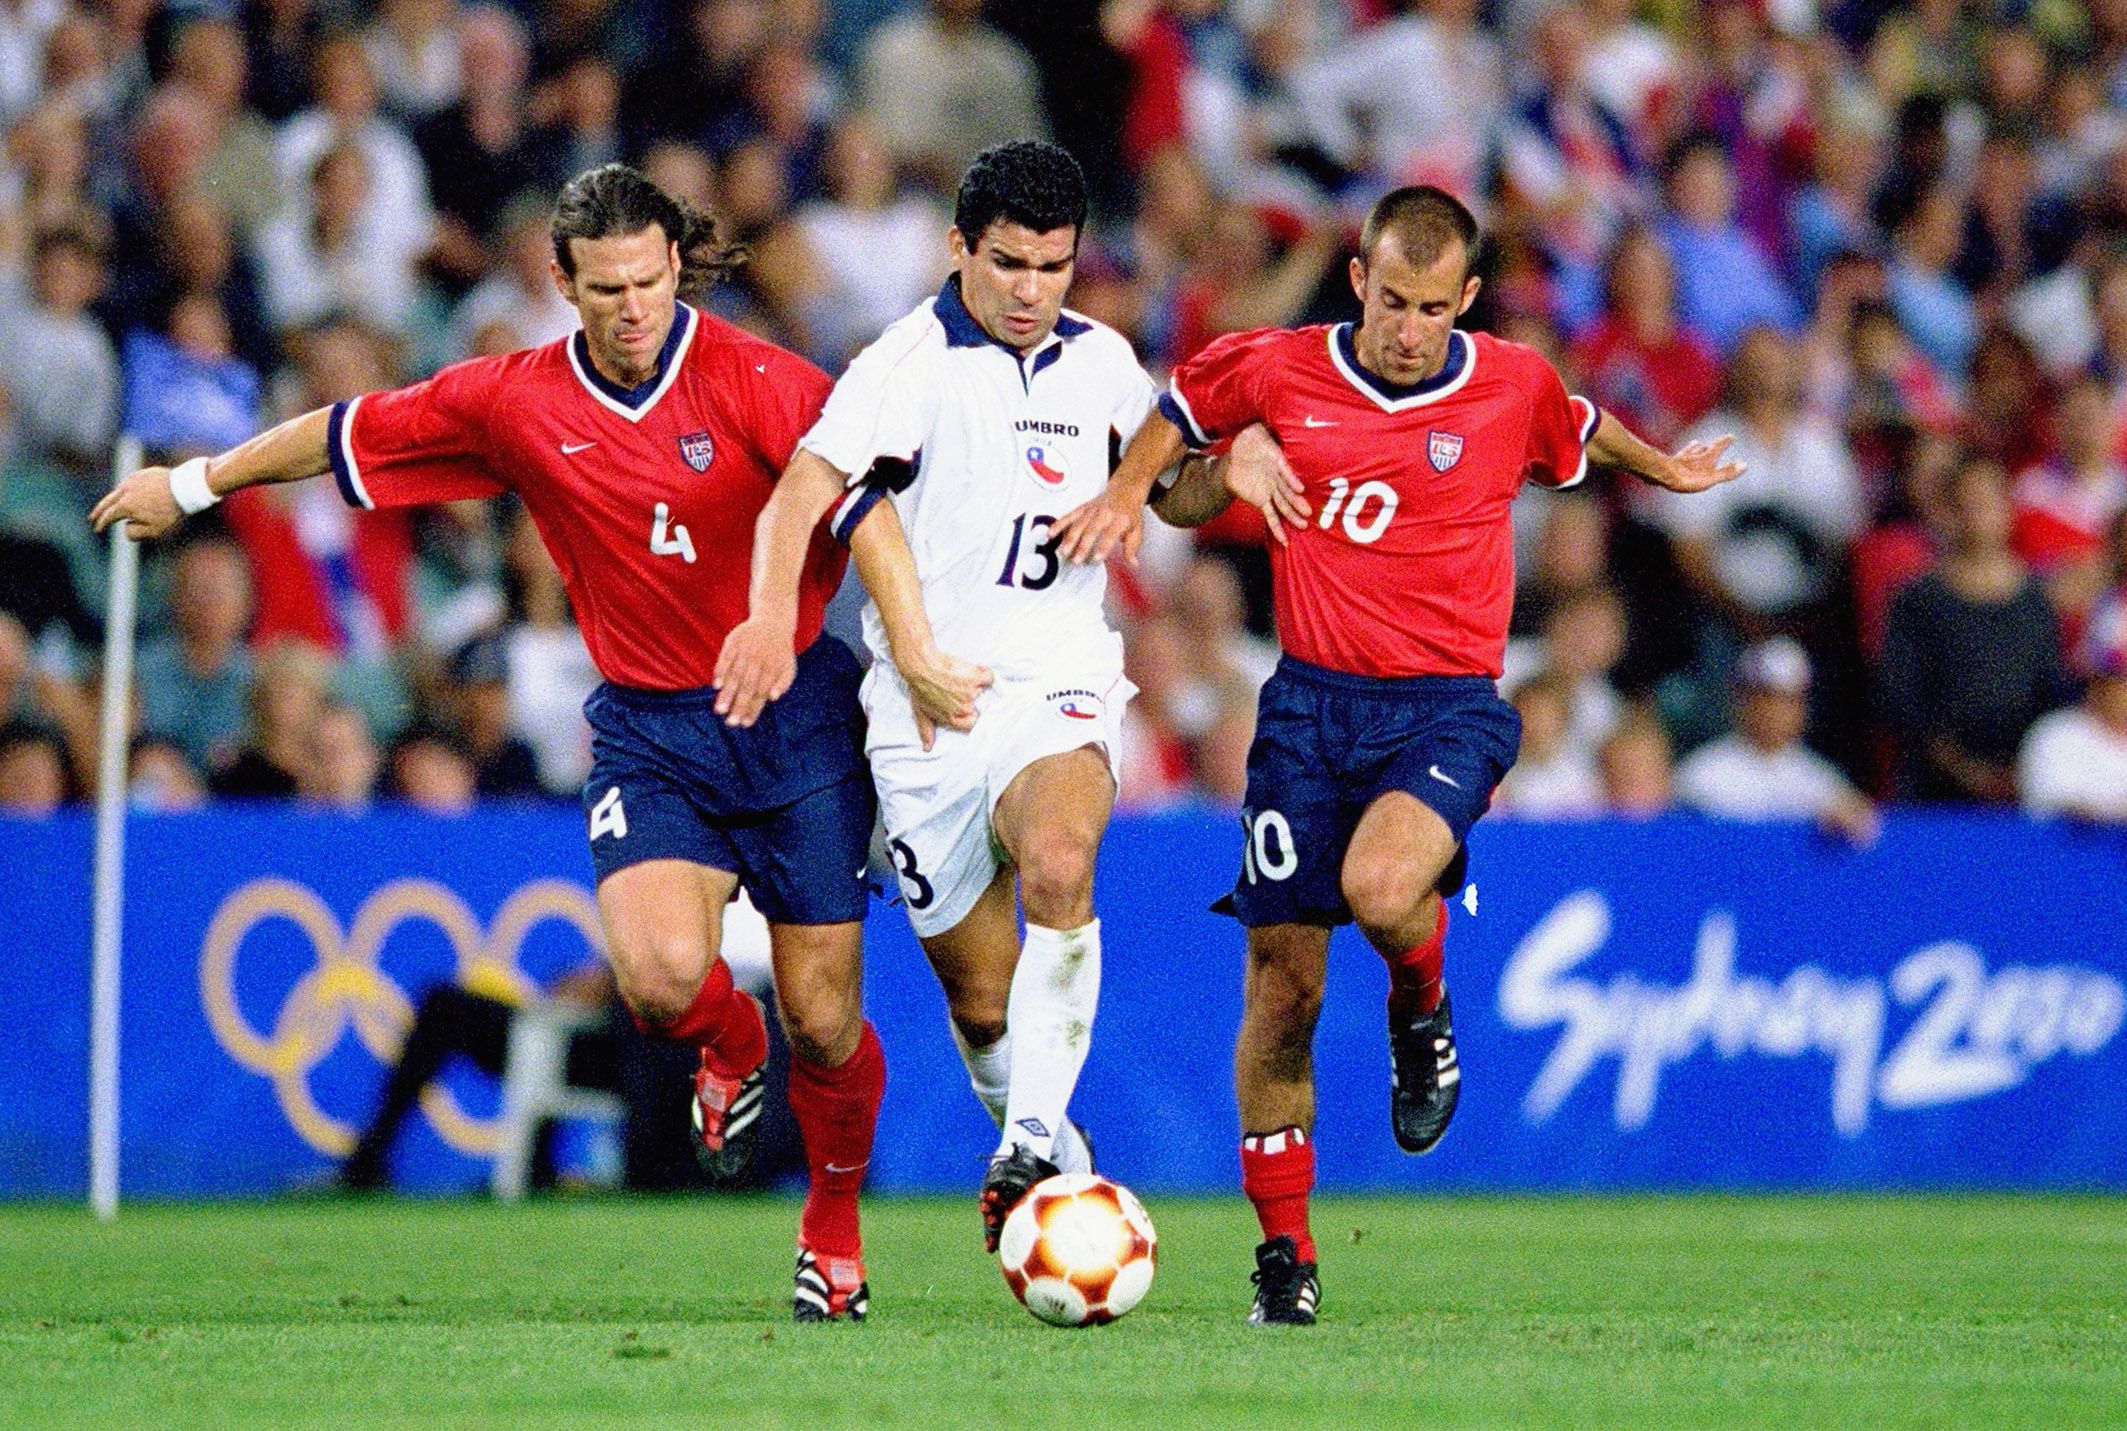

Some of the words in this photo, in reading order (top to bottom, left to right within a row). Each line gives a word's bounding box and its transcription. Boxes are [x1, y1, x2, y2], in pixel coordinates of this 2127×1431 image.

[1015, 419, 1080, 437] UMBRO
[649, 501, 698, 563] 4
[1318, 476, 1399, 544] 10
[995, 512, 1060, 591] 13
[590, 786, 628, 840] 4
[885, 838, 935, 910] 3
[1501, 889, 1886, 1138] Sydney
[1878, 940, 2126, 1110] 2000
